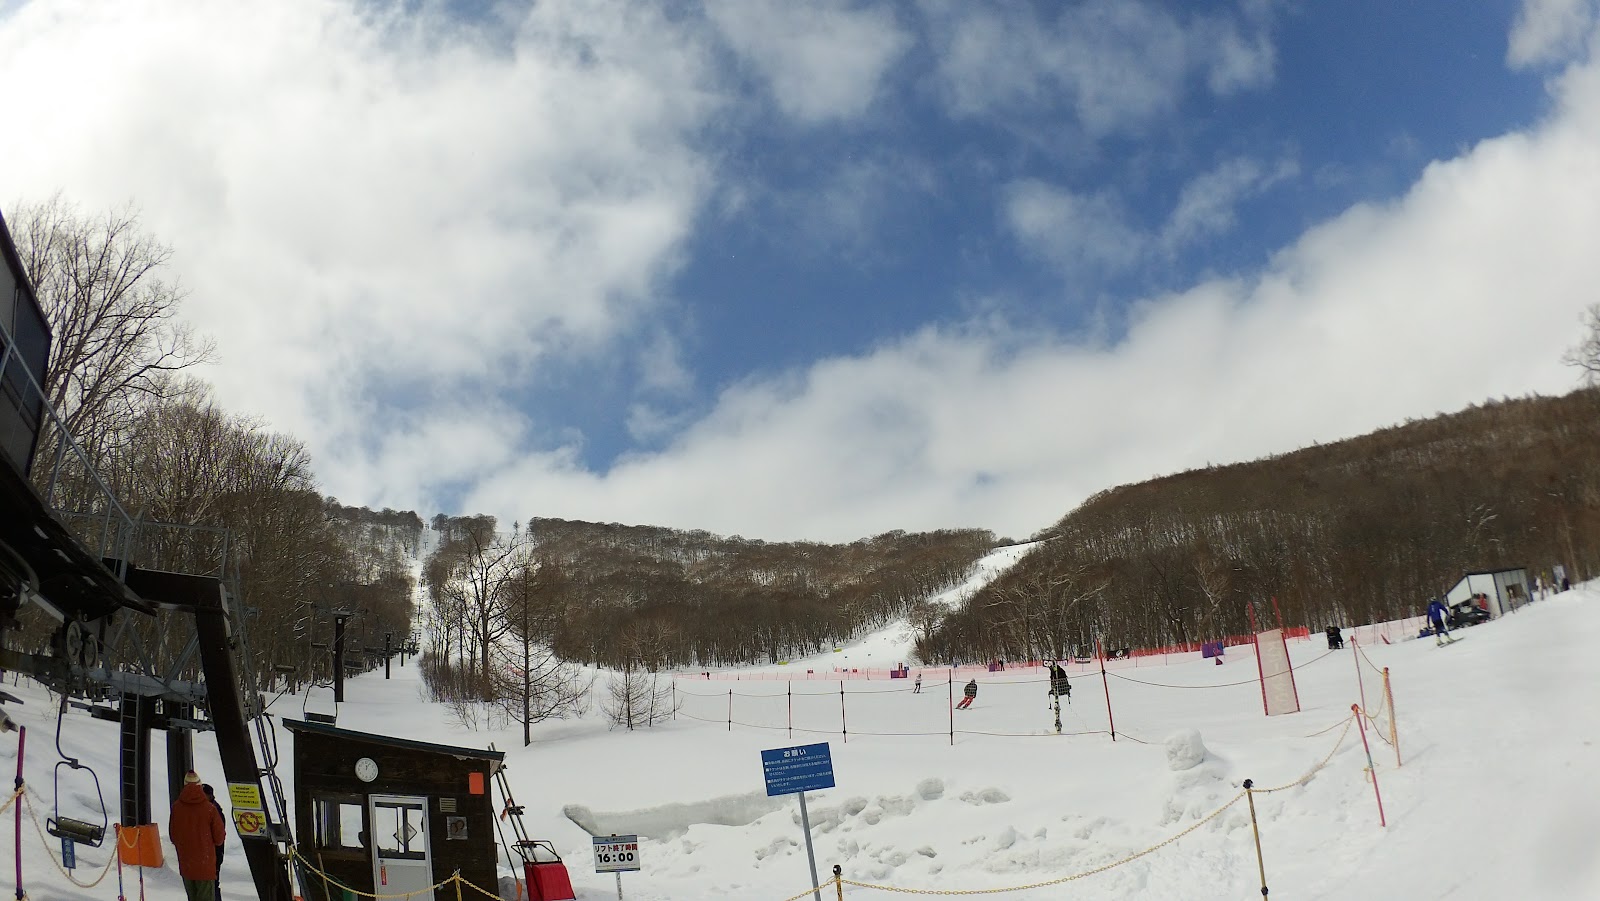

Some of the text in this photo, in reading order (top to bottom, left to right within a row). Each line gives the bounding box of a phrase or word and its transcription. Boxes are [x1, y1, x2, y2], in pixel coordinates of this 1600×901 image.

[783, 748, 807, 758] お願い
[595, 844, 638, 852] リフト終了時間
[597, 852, 634, 863] 16:00
